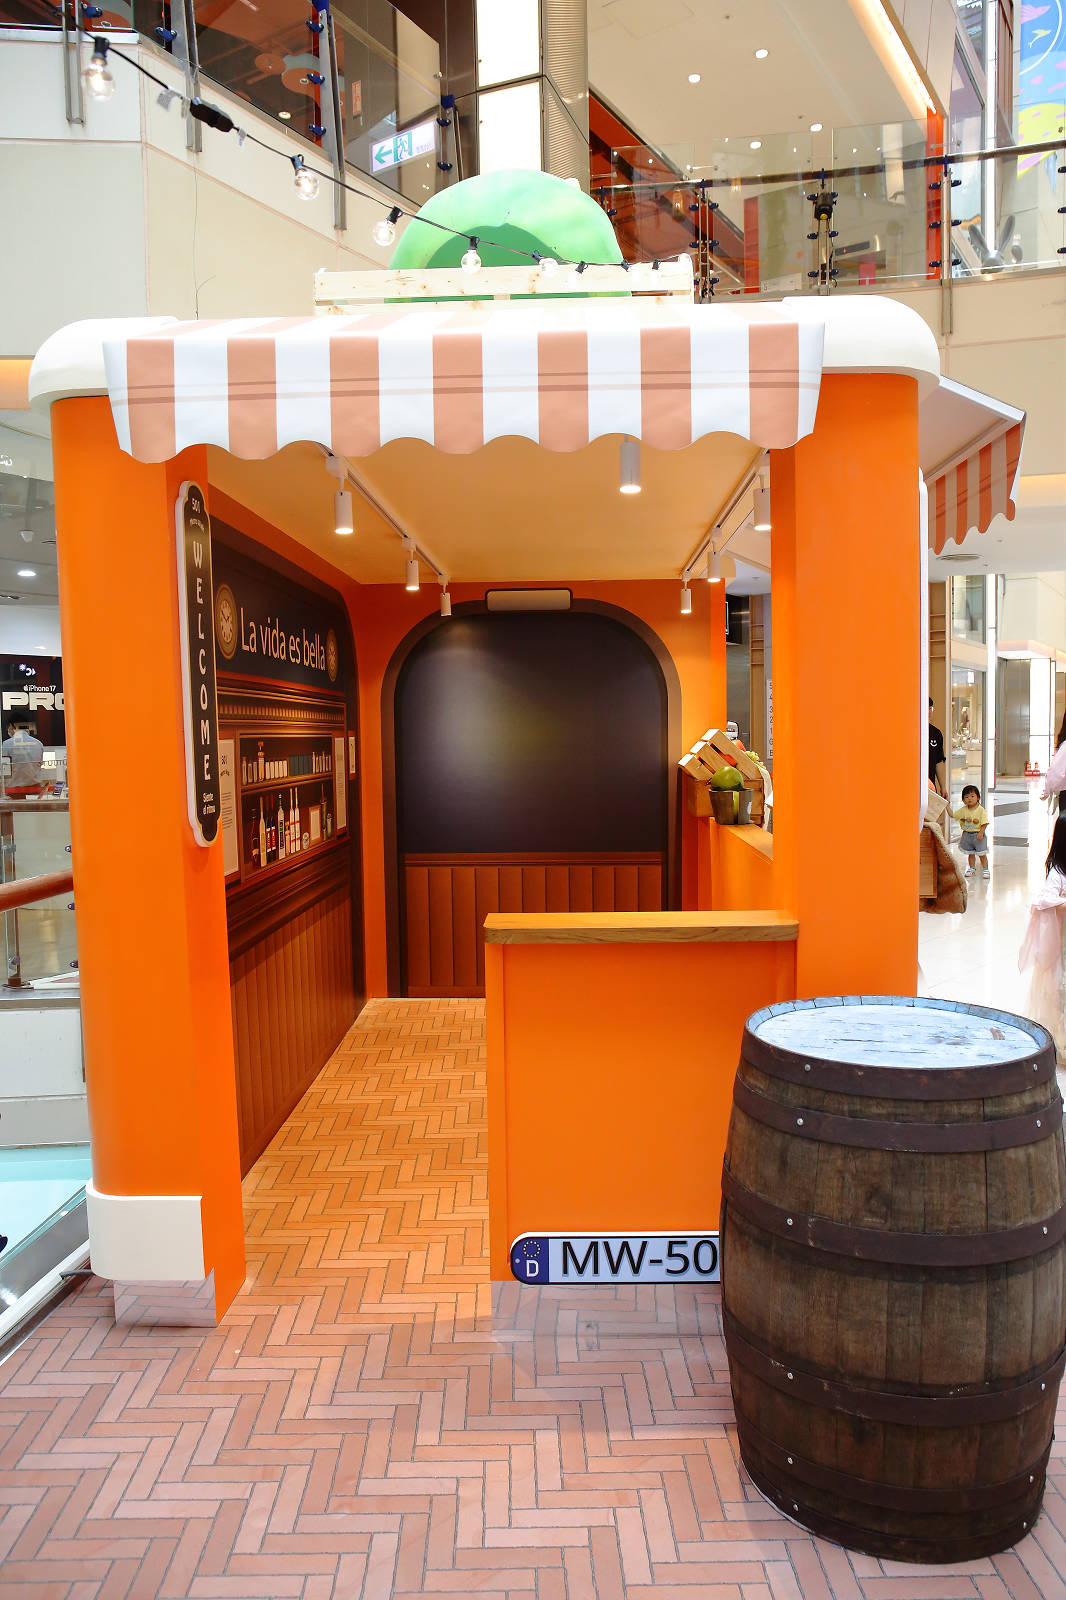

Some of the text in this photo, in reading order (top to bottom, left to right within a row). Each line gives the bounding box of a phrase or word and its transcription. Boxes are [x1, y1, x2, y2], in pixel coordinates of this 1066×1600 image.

[240, 607, 326, 671] La vida es bella
[192, 540, 212, 781] WELCOME
[28, 684, 50, 692] iPhone
[526, 1259, 540, 1278] D
[561, 1239, 718, 1276] MW-50
